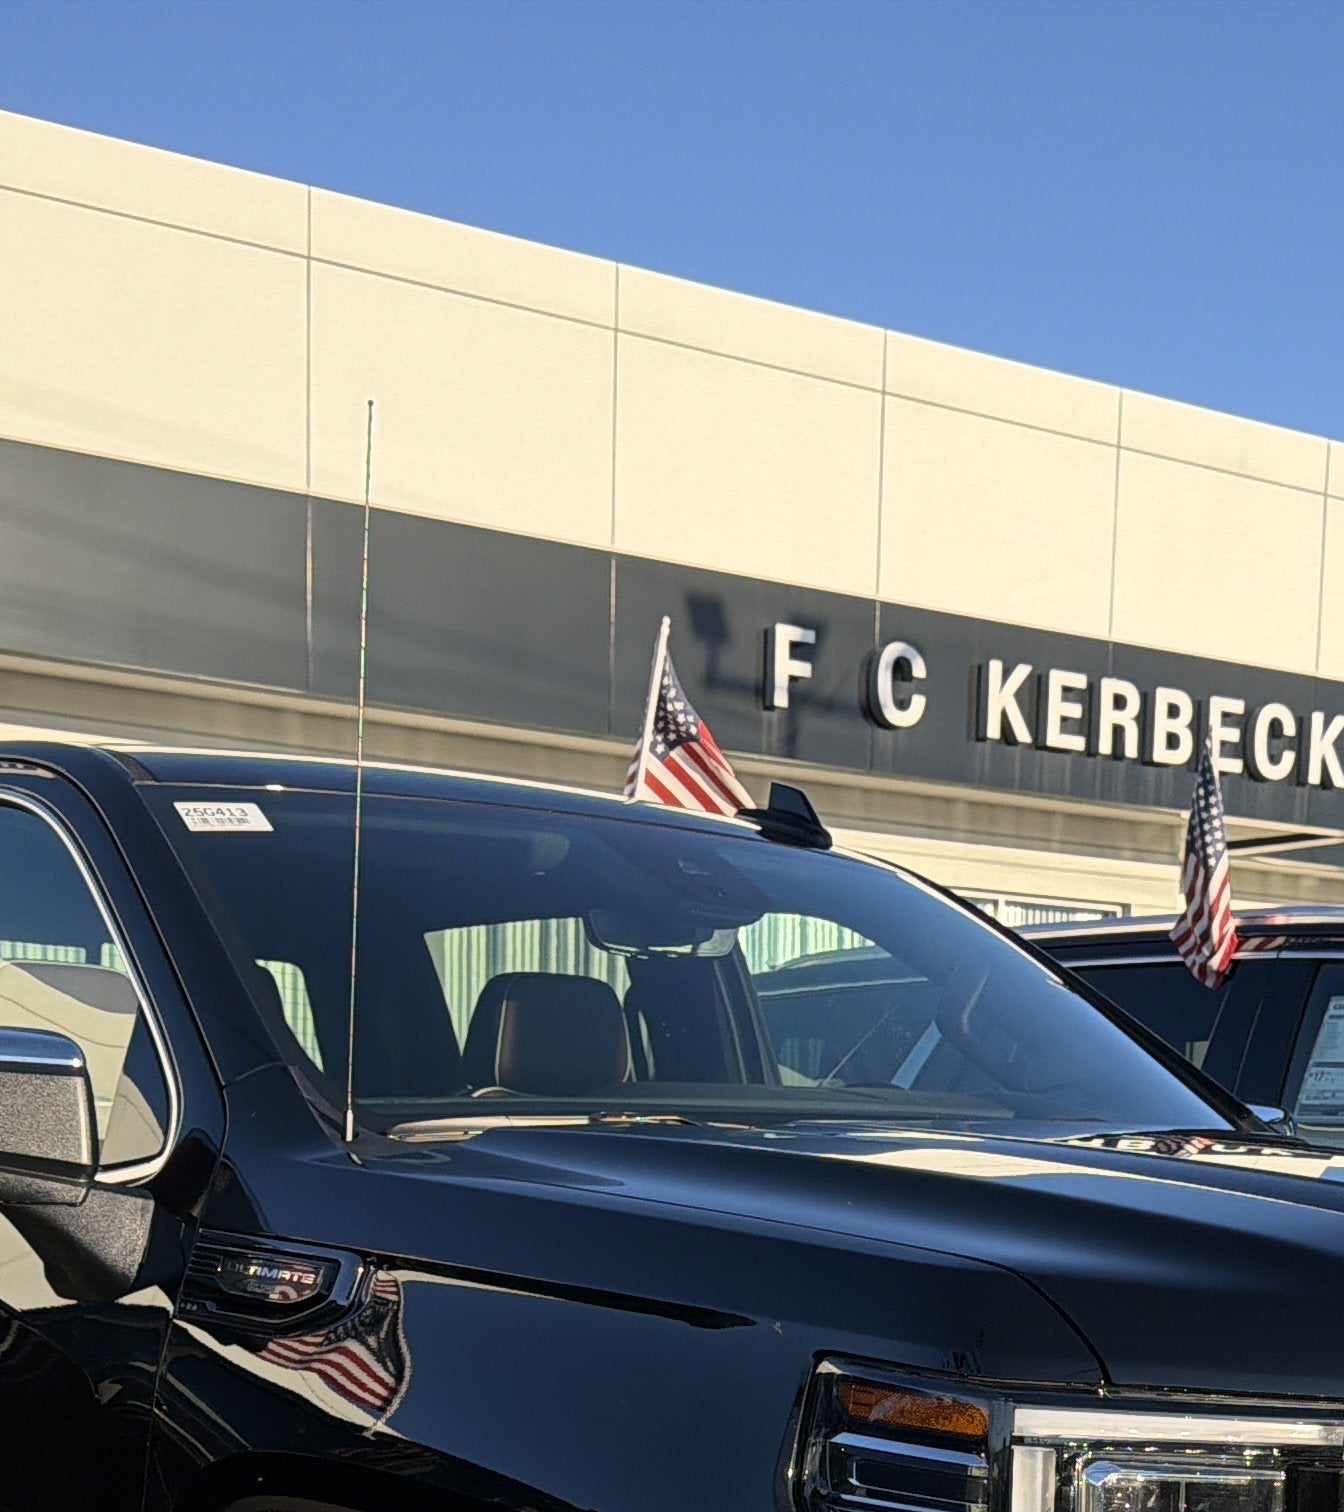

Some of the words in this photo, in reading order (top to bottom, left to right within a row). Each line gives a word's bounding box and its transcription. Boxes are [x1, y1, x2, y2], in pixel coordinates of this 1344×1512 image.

[773, 622, 816, 709] F
[877, 640, 928, 728] C
[227, 1262, 316, 1285] ULTIMATE
